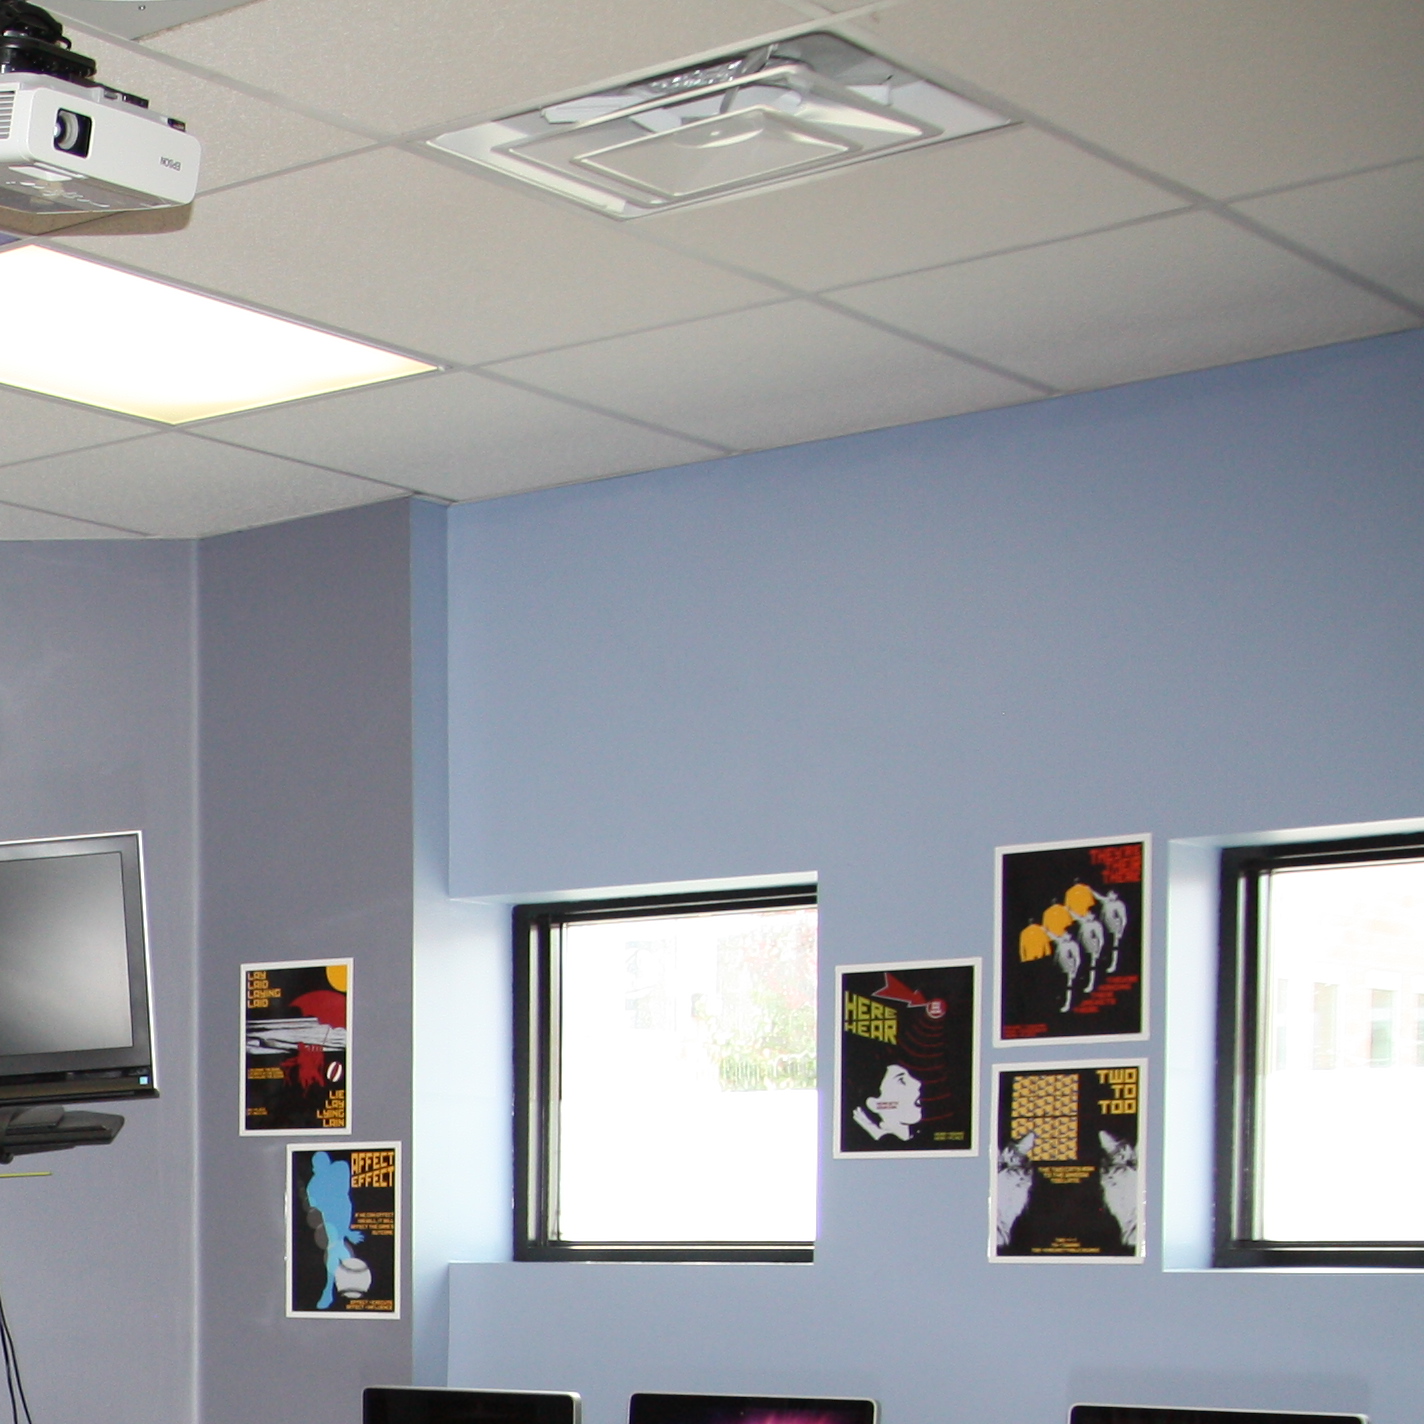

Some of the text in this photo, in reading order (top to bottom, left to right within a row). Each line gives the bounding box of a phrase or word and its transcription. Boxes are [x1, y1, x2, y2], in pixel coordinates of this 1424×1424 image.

[159, 156, 181, 171] EPSON
[247, 971, 267, 980] LAY
[247, 980, 269, 990] LAID
[247, 988, 282, 999] LAYING
[247, 998, 269, 1008] LAID
[845, 991, 898, 1020] HERE
[844, 1019, 898, 1046] HEAR
[1096, 1068, 1137, 1084] TWO
[329, 1090, 345, 1099] LIE
[1111, 1084, 1137, 1098] TO
[325, 1099, 345, 1109] LAY
[1097, 1099, 1137, 1114] TOO
[316, 1109, 345, 1118] LYING
[322, 1118, 345, 1128] LAIN
[351, 1151, 394, 1175] AFFECT
[351, 1165, 394, 1187] EFFECT
